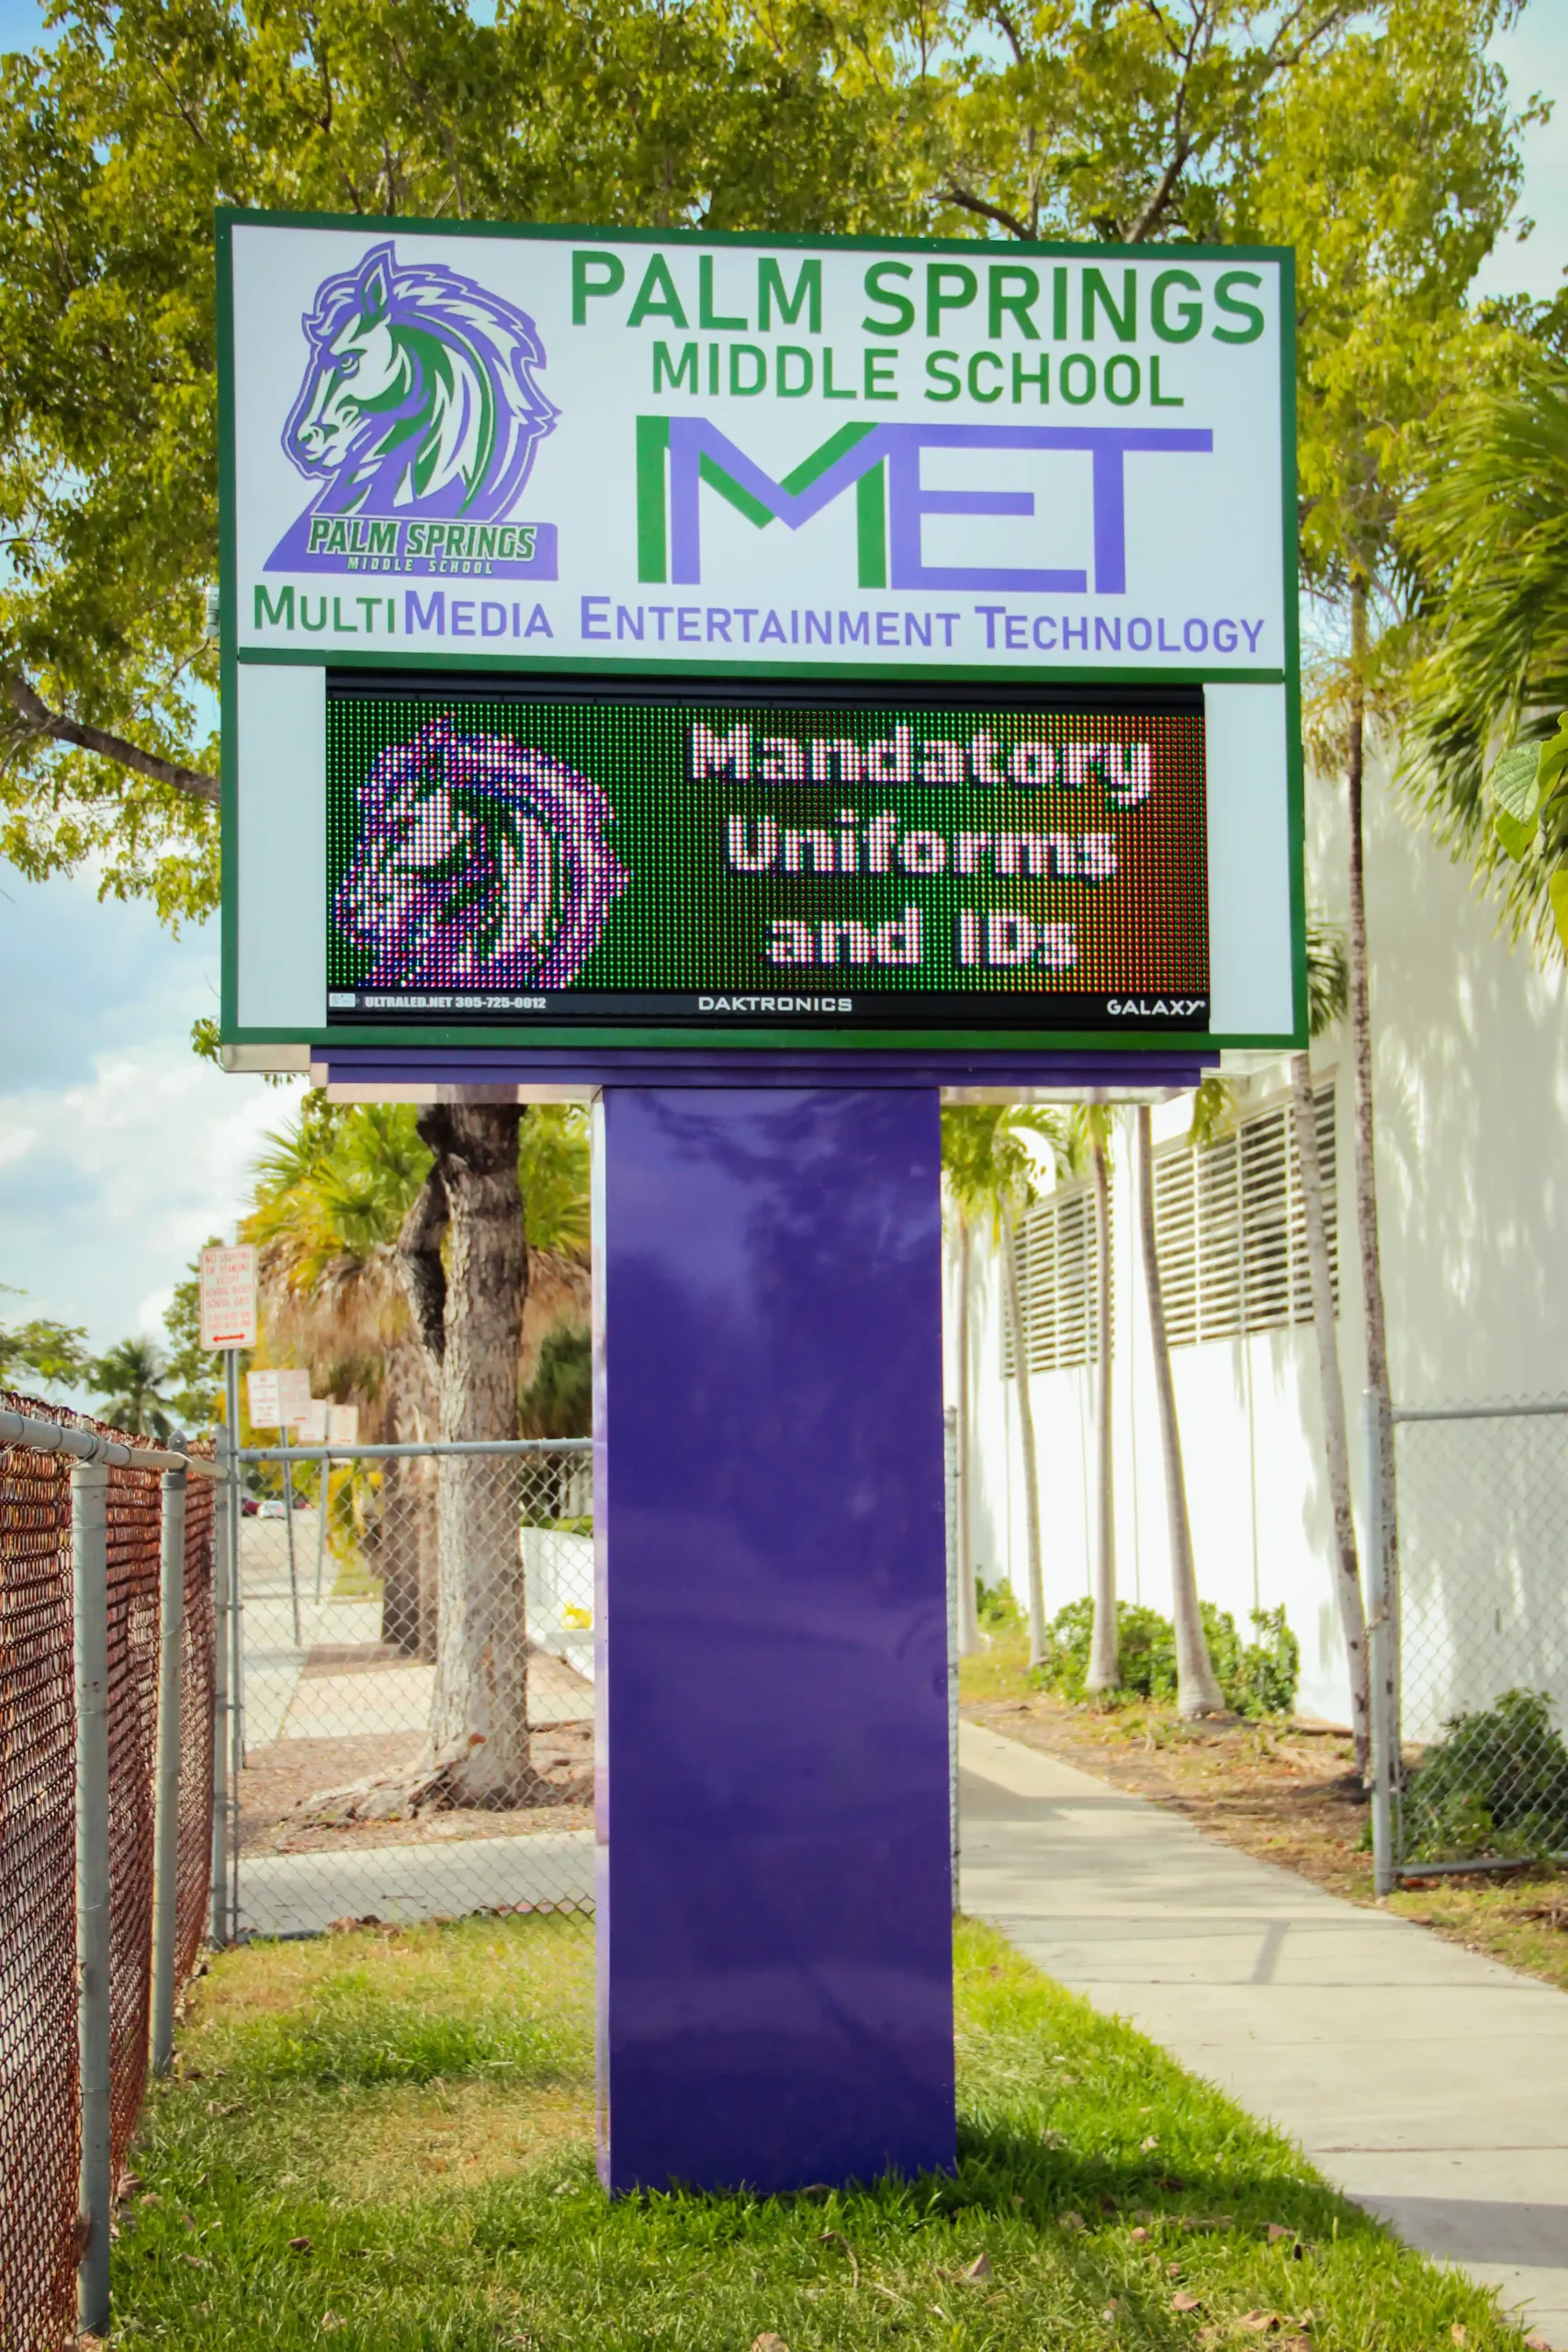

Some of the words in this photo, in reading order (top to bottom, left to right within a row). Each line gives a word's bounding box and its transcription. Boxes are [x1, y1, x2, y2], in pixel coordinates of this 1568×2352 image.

[571, 250, 823, 334] PALM
[862, 261, 1265, 345] SPRINGS
[652, 341, 899, 401] MIDDLE
[924, 350, 1184, 407] SCHOOL
[636, 414, 1213, 594] MET
[307, 516, 400, 557] PALM
[405, 521, 537, 562] SPRINGS
[346, 556, 414, 572] MIDDLE
[428, 560, 493, 576] SCHOOL
[581, 595, 962, 649] ENTERTAINMENT
[975, 605, 1265, 654] TECHNOLOGY
[690, 721, 1153, 806] Mandatory
[727, 808, 1119, 876] Uniforms
[765, 905, 923, 965] and
[959, 908, 1079, 966] IDs
[364, 996, 453, 1009] ULTRALED.NET
[456, 996, 547, 1009] 305-725-0012
[698, 996, 852, 1012] DAKTRONICS
[1106, 999, 1201, 1015] GALAXY
[205, 1252, 217, 1264] NO
